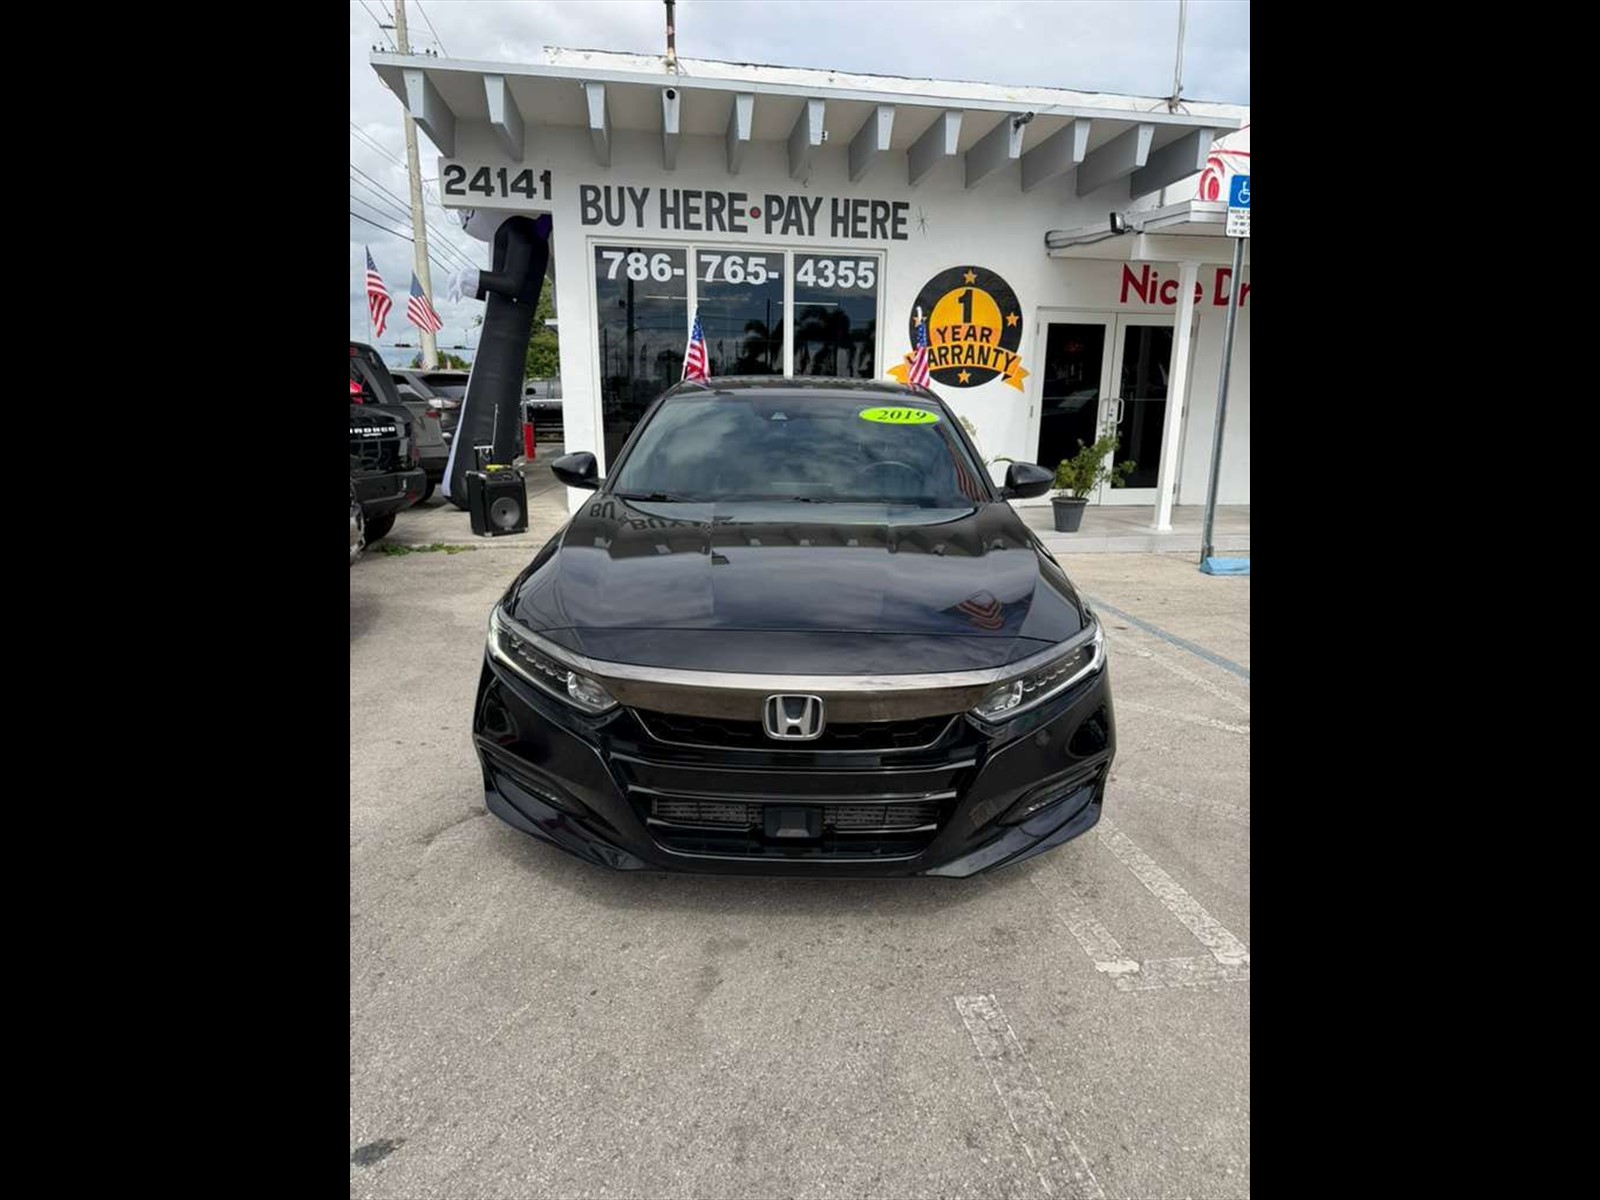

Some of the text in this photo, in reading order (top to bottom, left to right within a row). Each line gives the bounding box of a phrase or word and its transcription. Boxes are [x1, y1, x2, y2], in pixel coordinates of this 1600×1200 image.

[443, 164, 552, 200] 24141
[579, 184, 910, 240] BUY HERE PAY HERE
[602, 251, 876, 289] 786- 765- 4355
[958, 288, 974, 324] 1
[936, 325, 993, 344] YEAR
[906, 343, 1017, 373] ARRANTY
[877, 410, 928, 420] 2019
